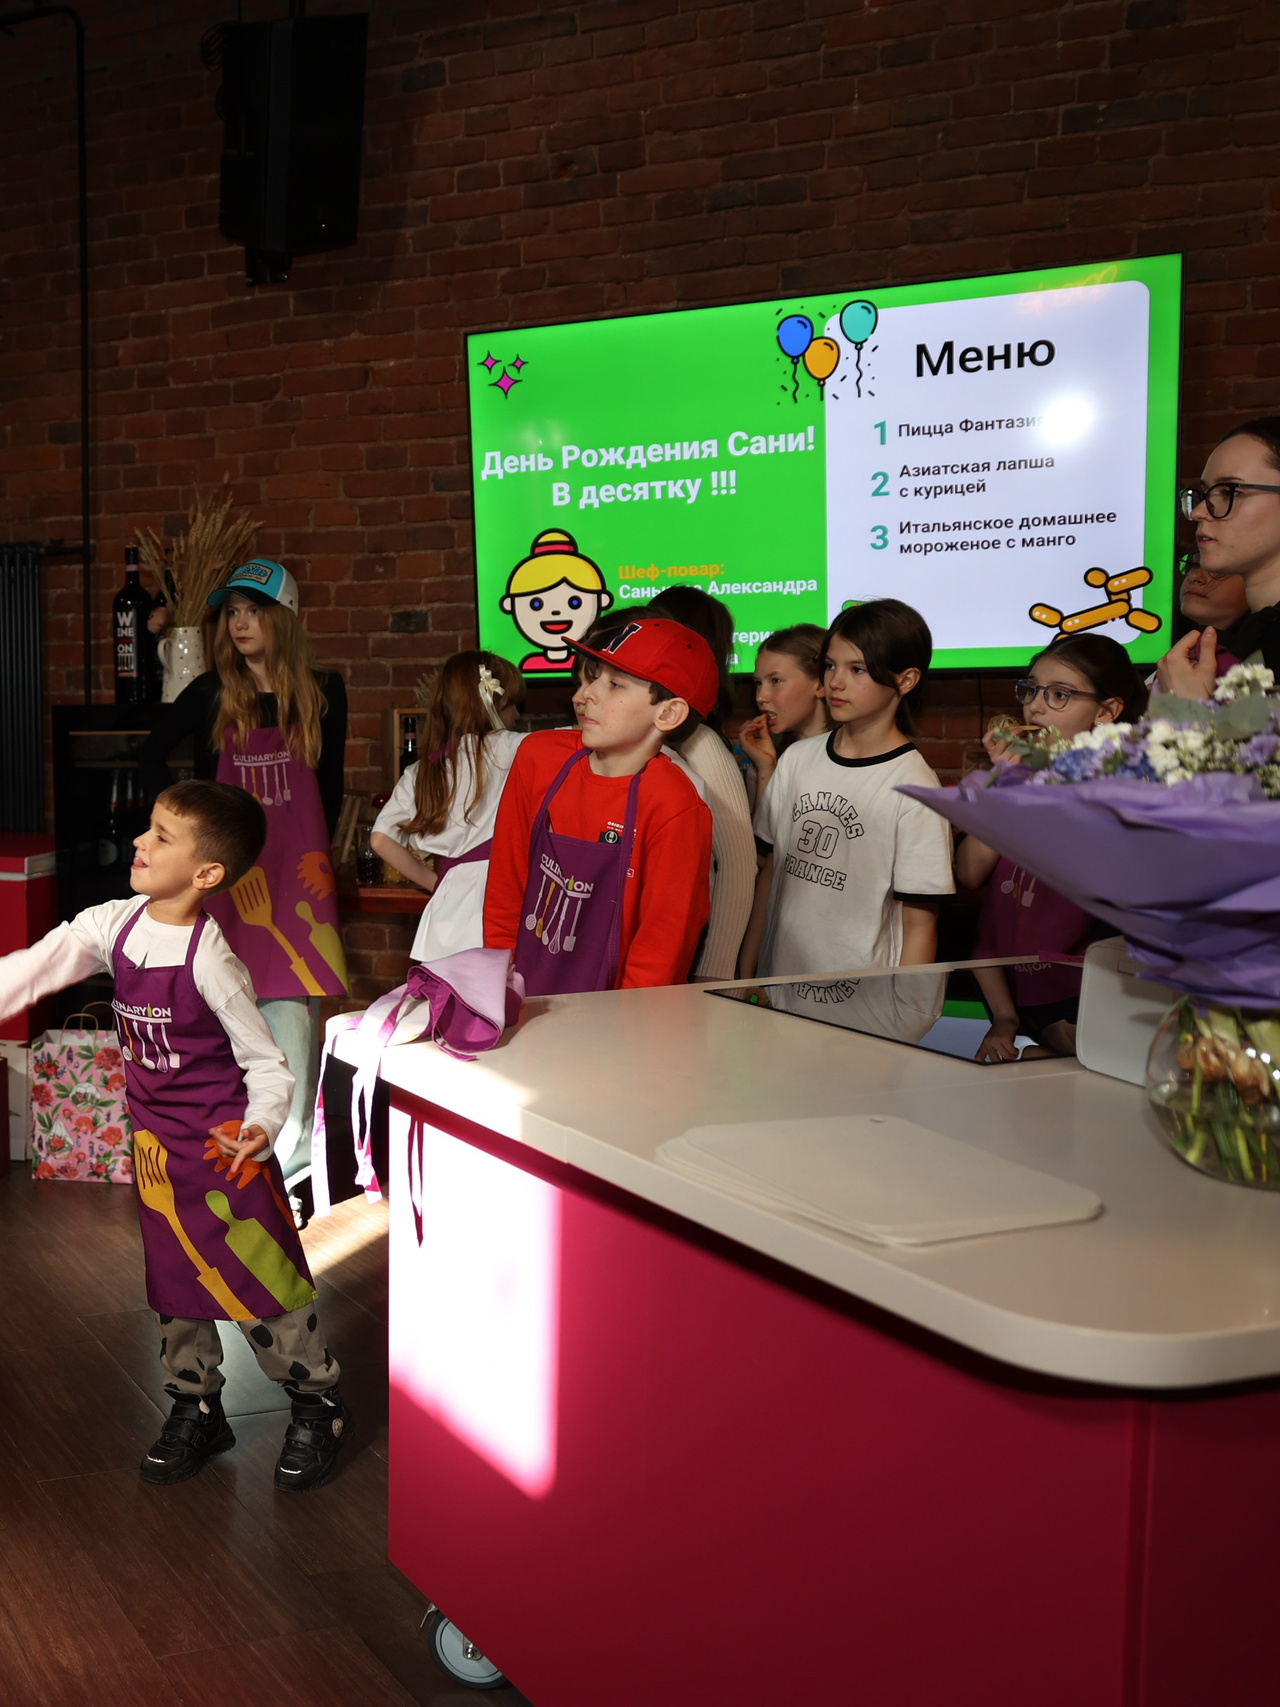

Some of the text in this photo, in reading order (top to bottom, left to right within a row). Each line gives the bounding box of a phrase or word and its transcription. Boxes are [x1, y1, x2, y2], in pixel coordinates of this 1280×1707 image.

[915, 339, 1056, 379] Меню
[873, 420, 888, 447] 1
[898, 422, 954, 438] Пицца
[481, 426, 816, 480] День Рождения Сани!
[899, 455, 1055, 479] Азиатская лапша
[552, 470, 737, 509] В десятку !!!
[870, 471, 890, 497] 2
[899, 478, 987, 500] с курицей
[899, 509, 1118, 535] Итальянское домашнее
[870, 525, 889, 550] 3
[899, 533, 1076, 556] мороженое с манго
[618, 560, 725, 582] Шеф-повар:
[707, 576, 817, 598] Александра
[792, 791, 865, 840] CANNES
[797, 819, 840, 859] 30
